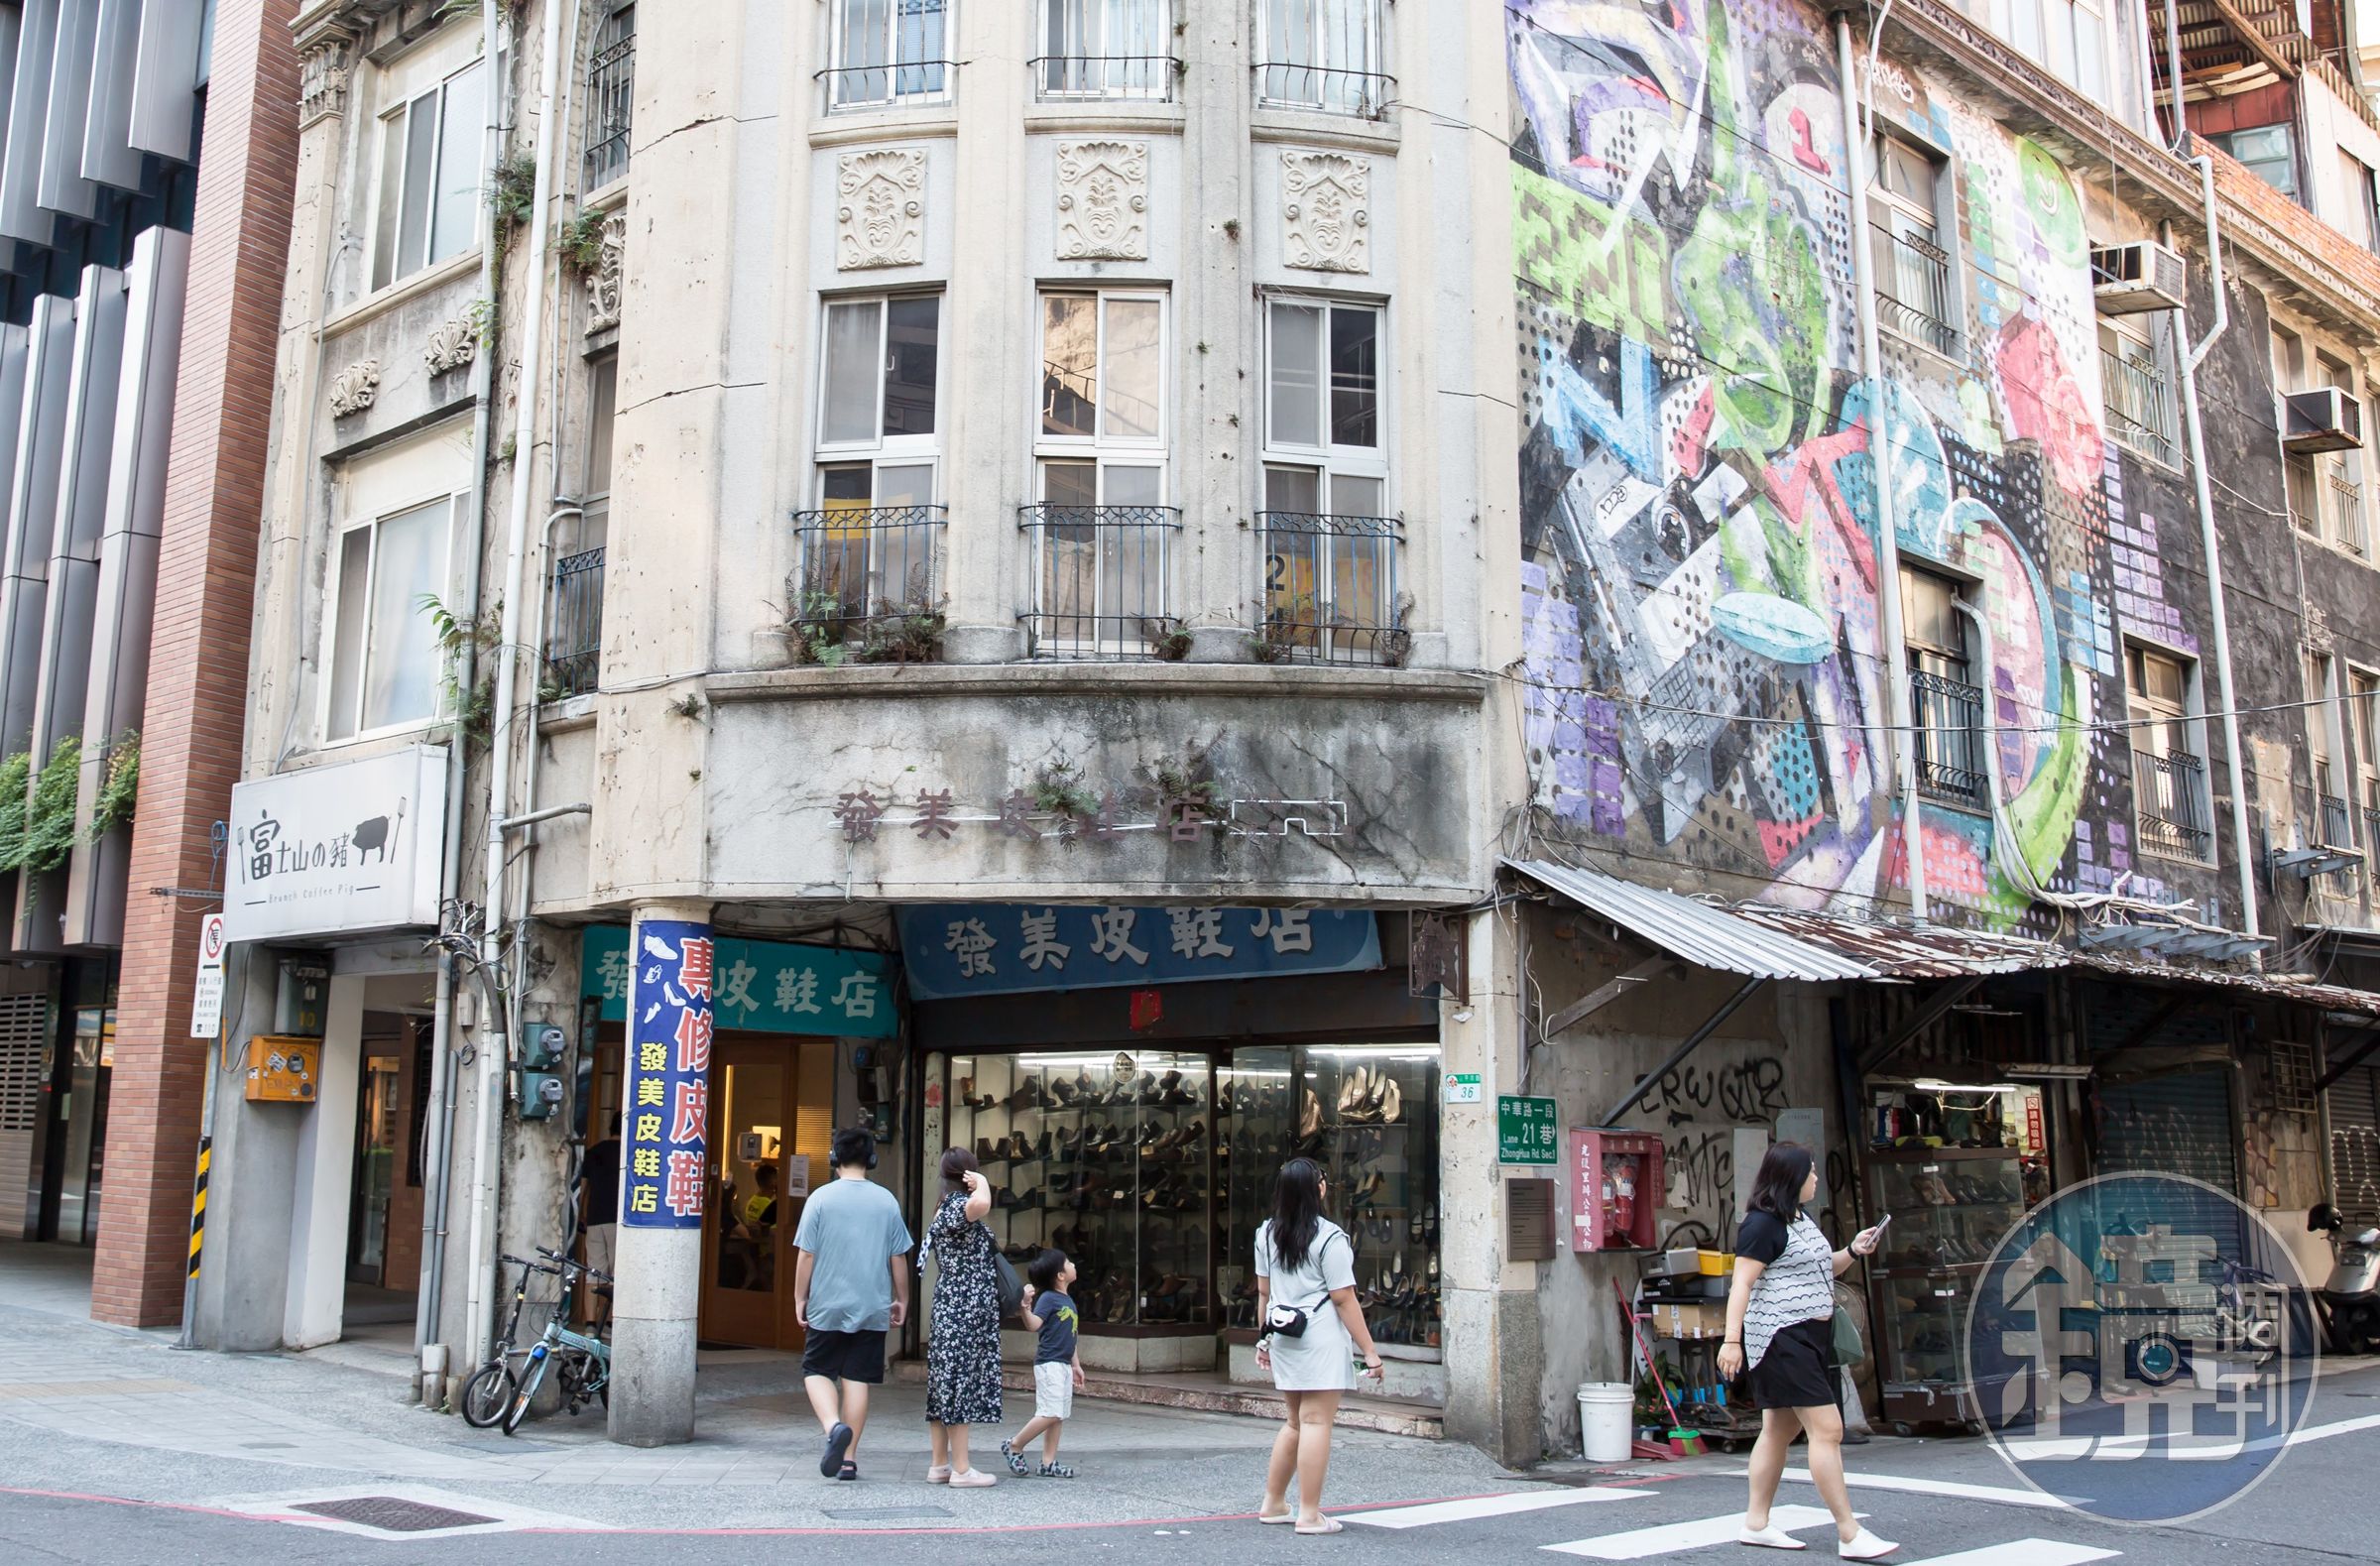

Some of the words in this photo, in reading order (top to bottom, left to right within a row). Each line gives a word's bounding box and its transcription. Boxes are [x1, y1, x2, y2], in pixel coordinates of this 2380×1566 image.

[943, 906, 1313, 978] 發美皮鞋店
[596, 949, 877, 1019] 發皮鞋店
[665, 936, 714, 1217] 專修皮鞋
[1461, 1087, 1475, 1098] 36
[631, 1042, 667, 1214] 發美皮鞋店
[1500, 1100, 1554, 1118] 中華路一段
[1500, 1147, 1530, 1160] ZhongHua
[1503, 1133, 1518, 1144] Lane
[1522, 1122, 1535, 1144] 21
[1539, 1123, 1555, 1144] 巷
